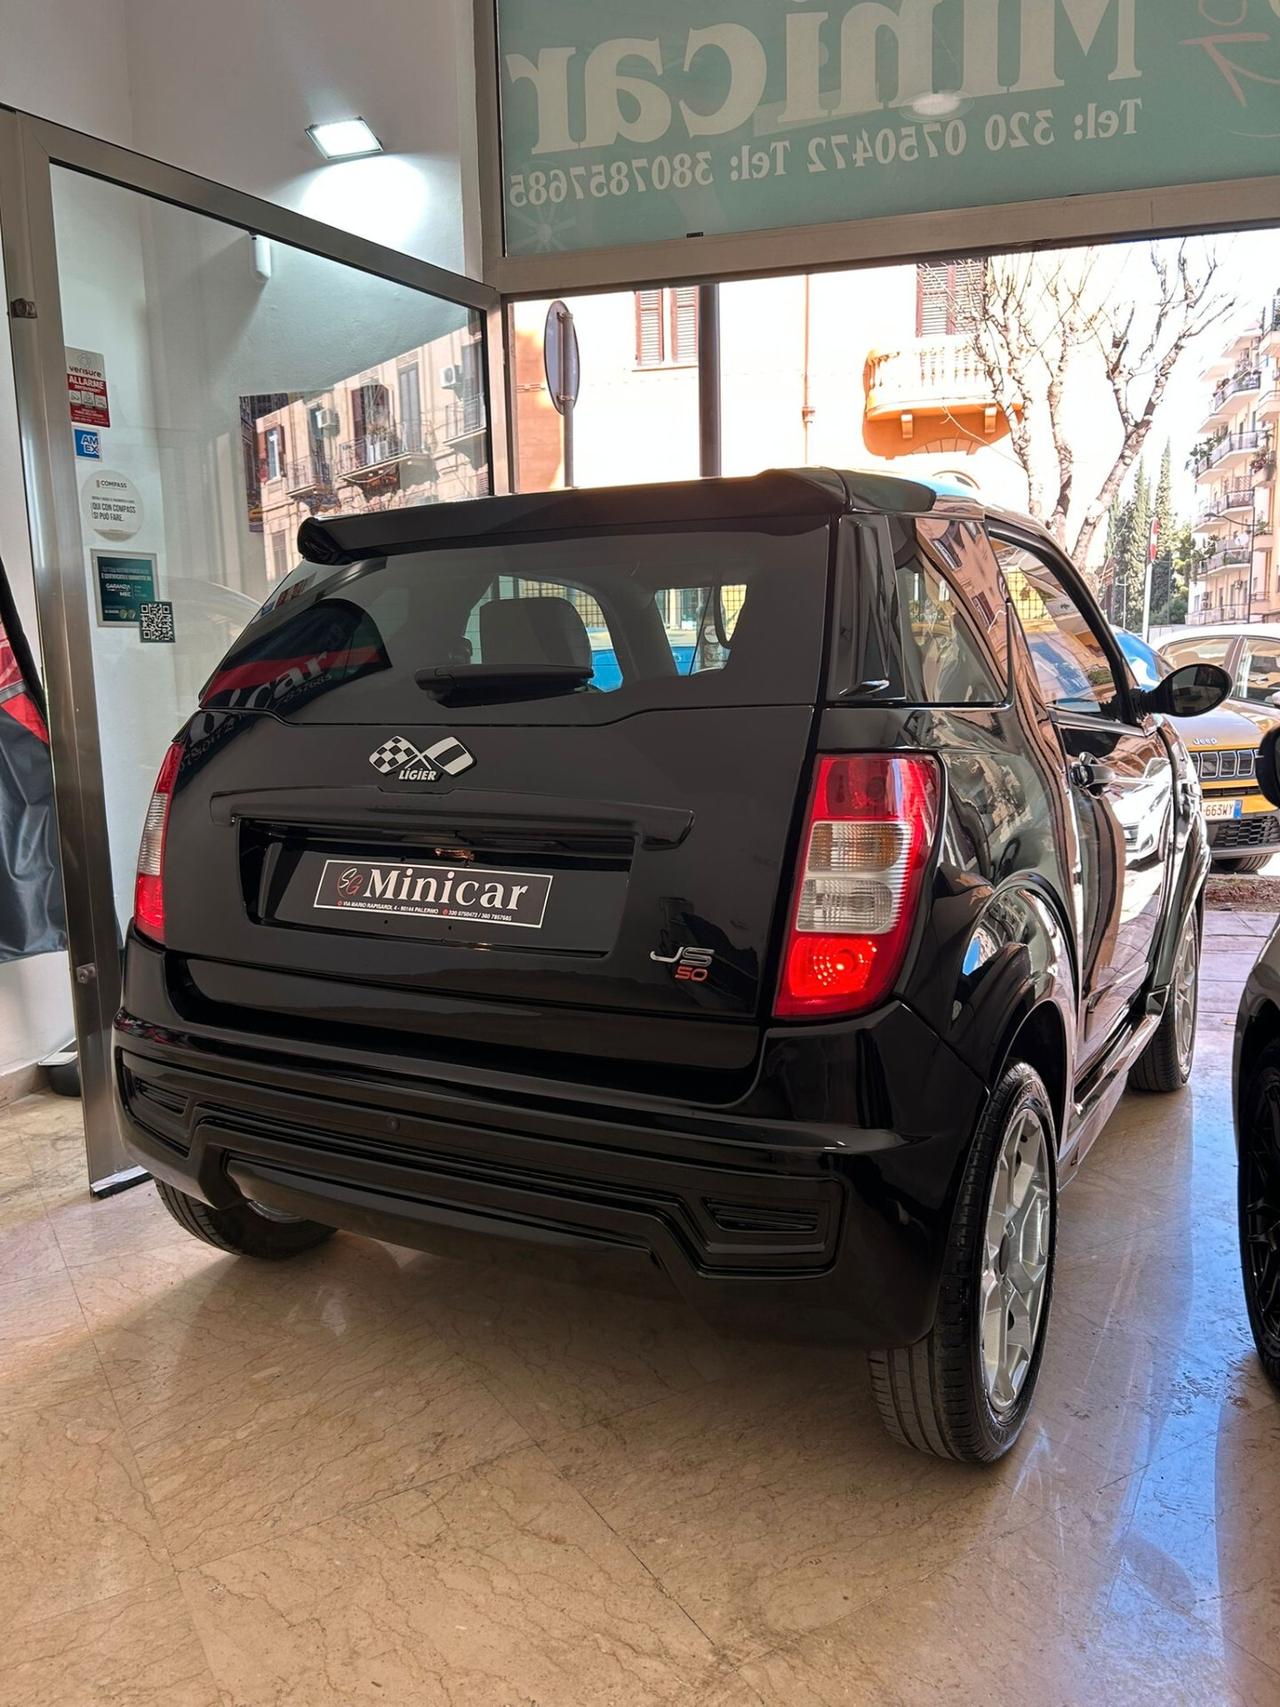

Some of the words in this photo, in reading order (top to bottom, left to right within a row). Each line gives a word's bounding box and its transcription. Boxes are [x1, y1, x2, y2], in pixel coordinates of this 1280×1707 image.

[69, 376, 104, 389] ALLARME
[1193, 737, 1218, 745] Jeep
[363, 867, 529, 911] Minicar
[650, 946, 715, 968] JS
[674, 966, 708, 983] 50
